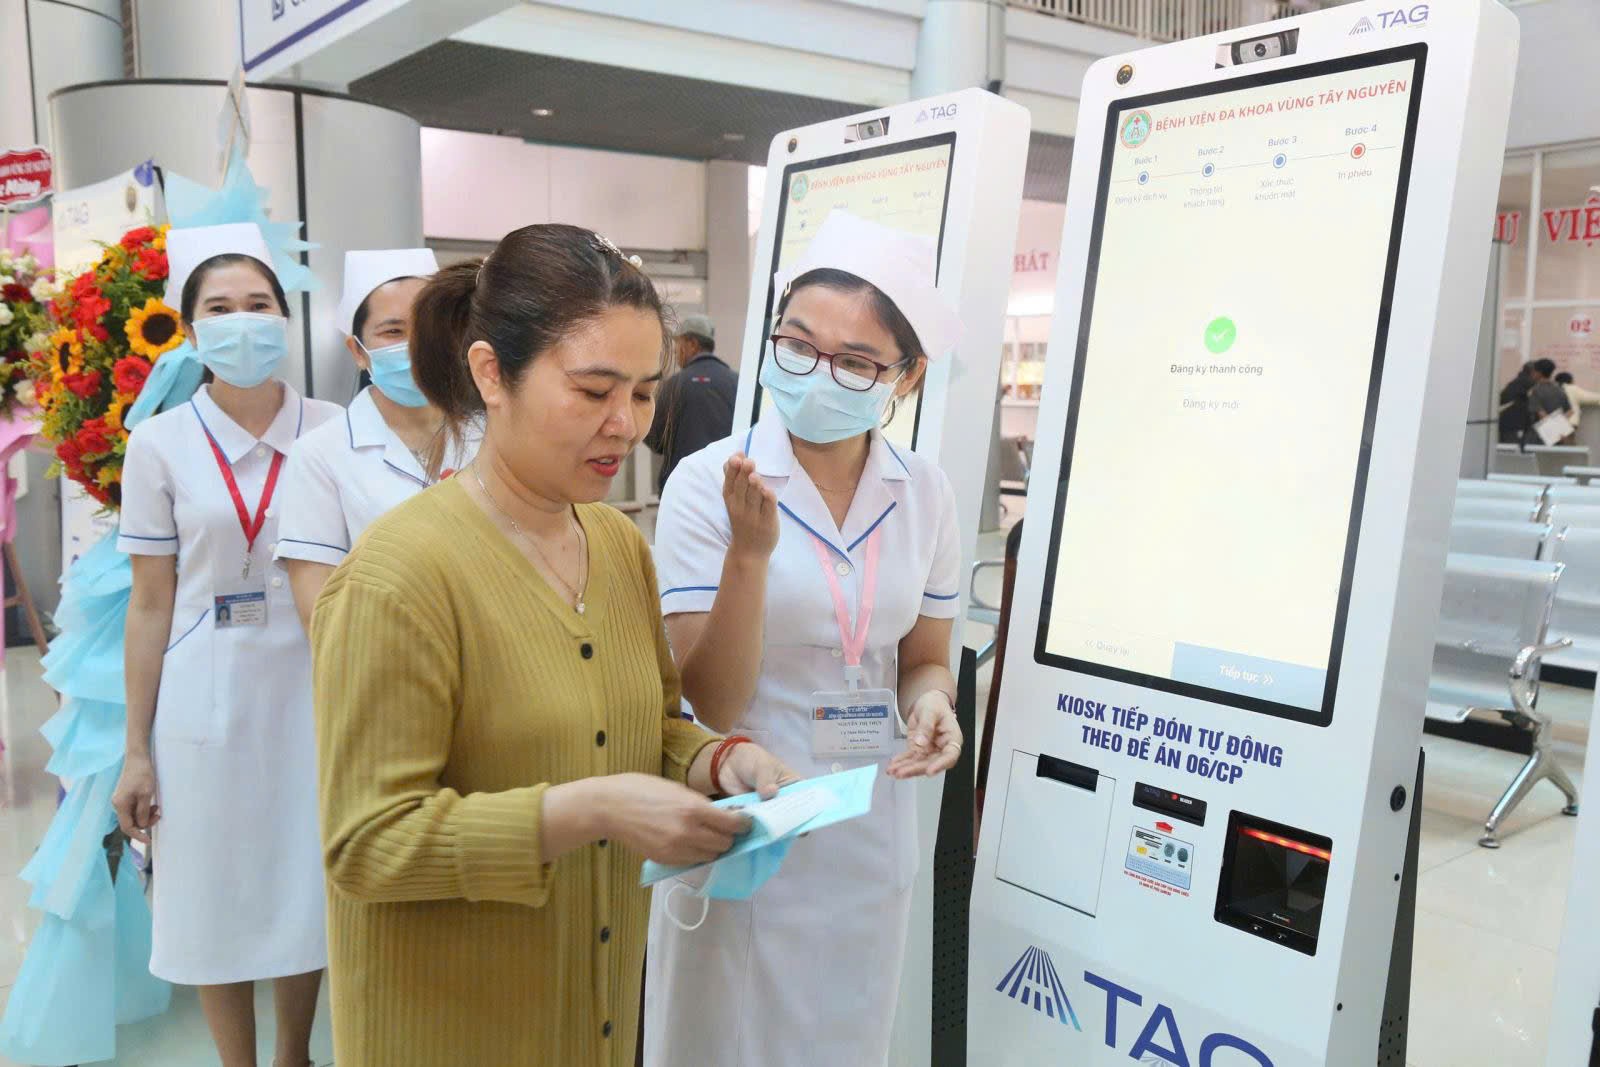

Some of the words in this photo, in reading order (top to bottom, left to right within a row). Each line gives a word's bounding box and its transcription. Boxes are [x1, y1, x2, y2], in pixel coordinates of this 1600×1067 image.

[1377, 5, 1429, 29] TAG
[930, 103, 957, 120] TAG
[1156, 116, 1186, 131] BỆNH
[1189, 111, 1216, 127] VIỆN
[1219, 110, 1236, 121] ĐA
[1239, 103, 1274, 118] KHOA
[1277, 95, 1315, 112] VÙNG
[1318, 89, 1344, 105] TÂY
[1346, 79, 1408, 101] NGUYÊN
[1371, 124, 1377, 133] 4
[1291, 136, 1298, 144] 3
[1218, 145, 1225, 154] 2
[1338, 172, 1346, 180] In
[1570, 318, 1591, 333] 02
[1218, 664, 1241, 681] Tiếp
[1241, 669, 1259, 684] tục
[1057, 693, 1108, 722] KIOSK
[1112, 704, 1149, 732] TIẾP
[1153, 716, 1193, 744] ĐÓN
[1198, 727, 1225, 756] TỰ
[1227, 735, 1284, 768] ĐỘNG
[1082, 725, 1123, 753] THEO
[1127, 736, 1152, 761] ĐỀ
[1154, 742, 1182, 770] ÁN
[1186, 753, 1244, 785] 06/CP
